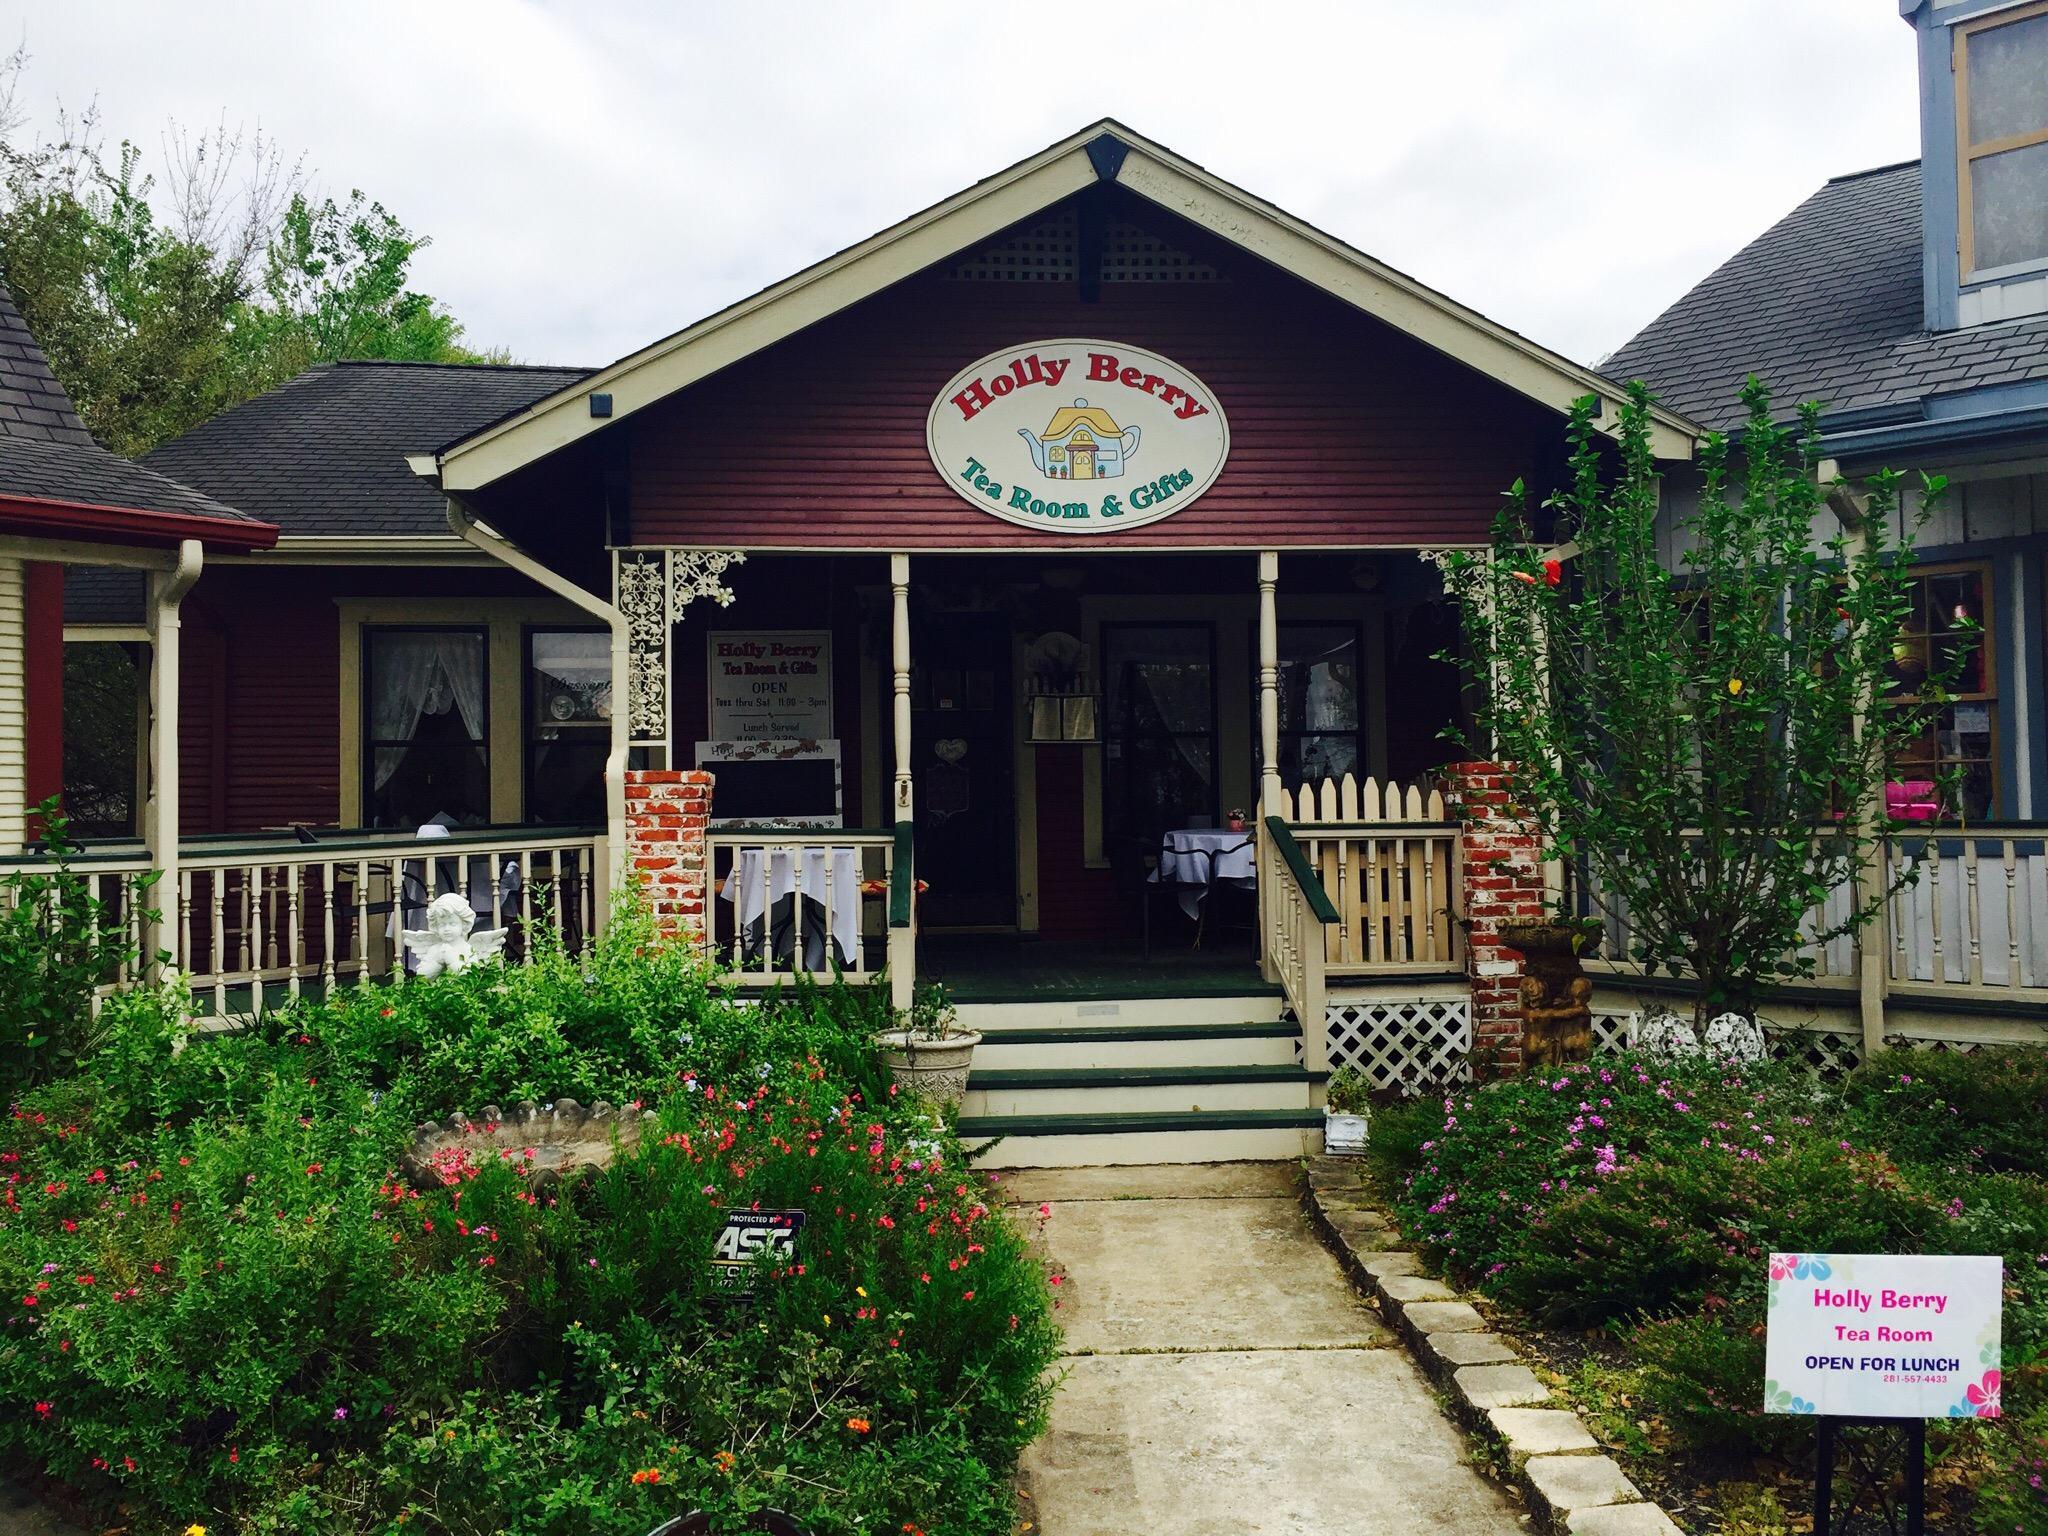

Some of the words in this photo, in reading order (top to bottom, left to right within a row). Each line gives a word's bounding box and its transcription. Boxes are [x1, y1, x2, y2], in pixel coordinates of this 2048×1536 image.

[950, 354, 1070, 421] Holly
[1086, 353, 1209, 419] Berry
[960, 457, 1003, 500] Tea
[1007, 485, 1090, 518] Room
[1100, 495, 1124, 517] &
[1129, 468, 1194, 509] Gifts
[717, 641, 766, 658] Holly
[770, 643, 821, 658] Berry
[723, 662, 742, 675] Tea
[744, 662, 776, 674] Room
[779, 662, 789, 674] &
[790, 661, 817, 674] Gifts
[752, 682, 787, 693] OPEN
[736, 697, 753, 707] thru
[743, 723, 768, 732] Lunch
[771, 722, 800, 732] Served
[730, 1214, 768, 1223] PROTECTED
[1814, 1289, 1872, 1312] Holly
[1881, 1290, 1948, 1314] Berry
[1835, 1326, 1870, 1341] Tea
[1878, 1326, 1933, 1342] Room
[1805, 1356, 1854, 1370] OPEN
[1860, 1358, 1896, 1371] FOR
[1901, 1358, 1960, 1371] LUNCH
[1883, 1375, 1947, 1384] 281-557-4433
